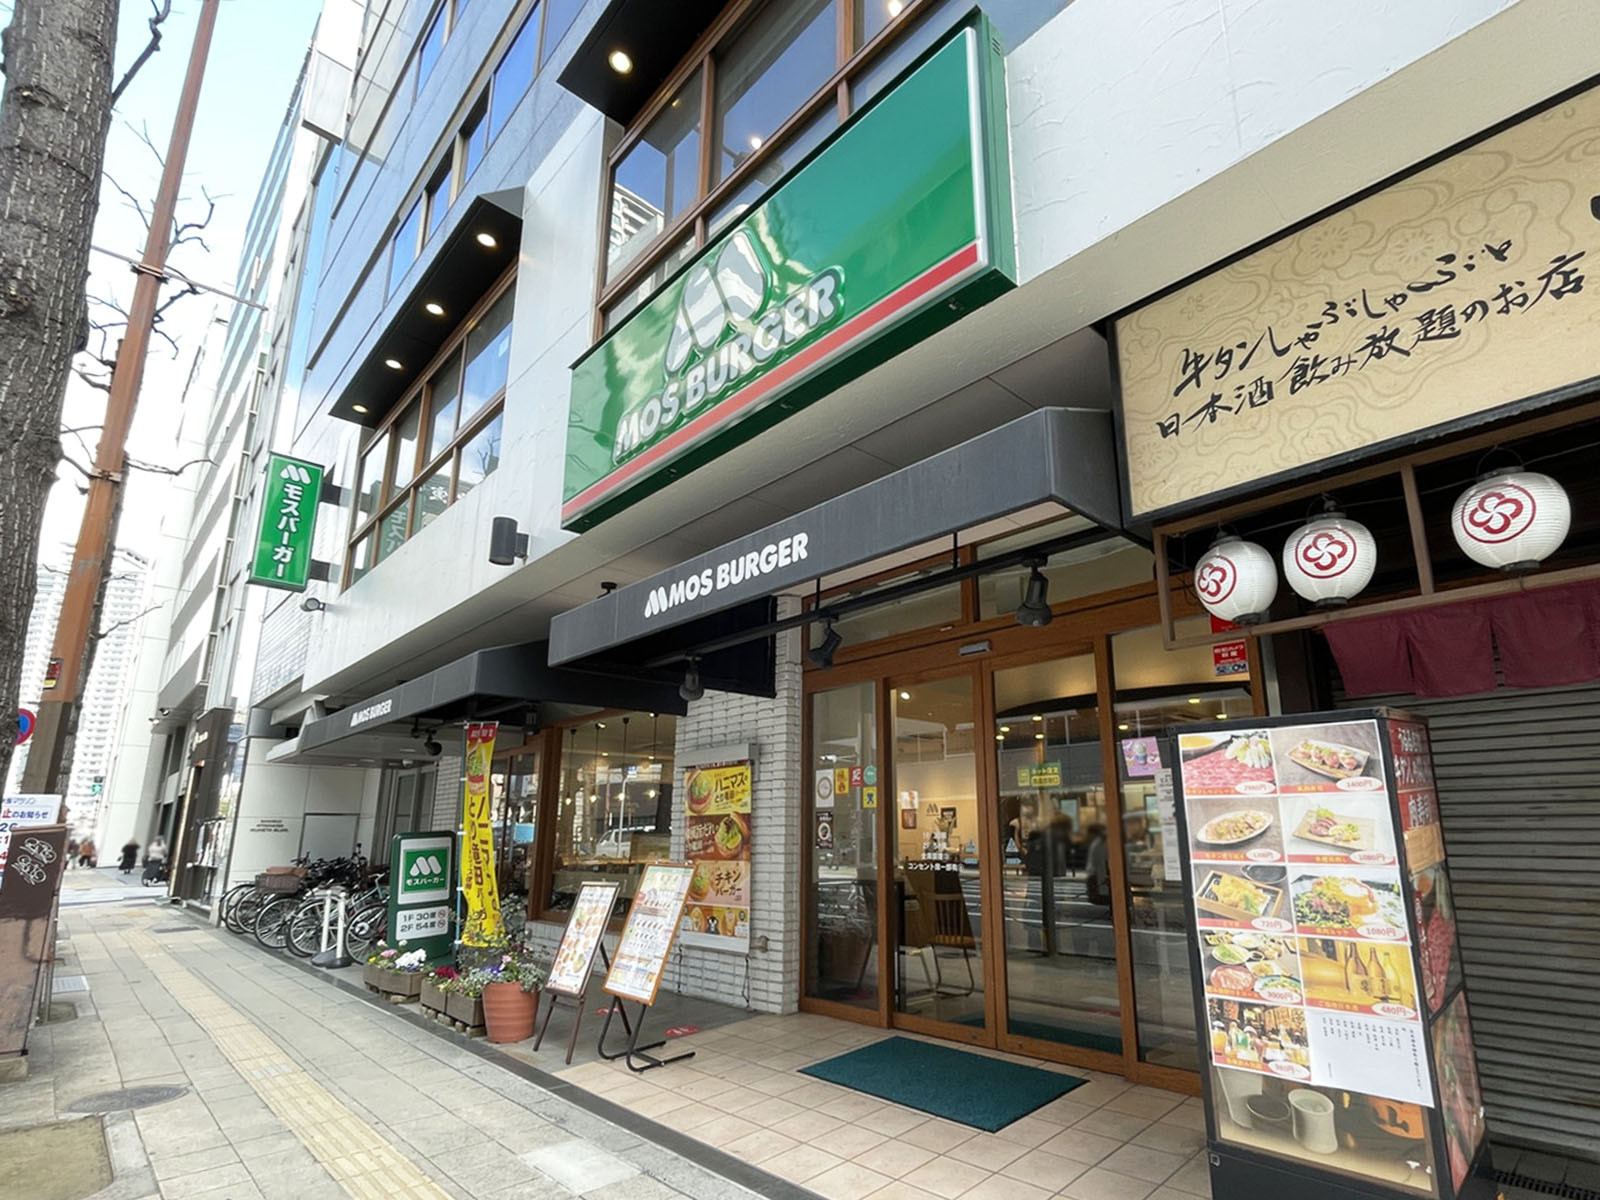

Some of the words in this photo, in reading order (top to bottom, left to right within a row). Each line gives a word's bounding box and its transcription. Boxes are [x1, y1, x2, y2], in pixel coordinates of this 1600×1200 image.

[615, 381, 680, 457] MOS
[684, 273, 838, 411] BURGER
[1156, 250, 1586, 440] 日本酒飲み放題のお店
[272, 483, 303, 578] モスバーガー
[668, 568, 713, 609] MOS
[716, 532, 809, 590] BURGER
[406, 877, 444, 887] モスバーガー
[715, 870, 741, 887] チキン
